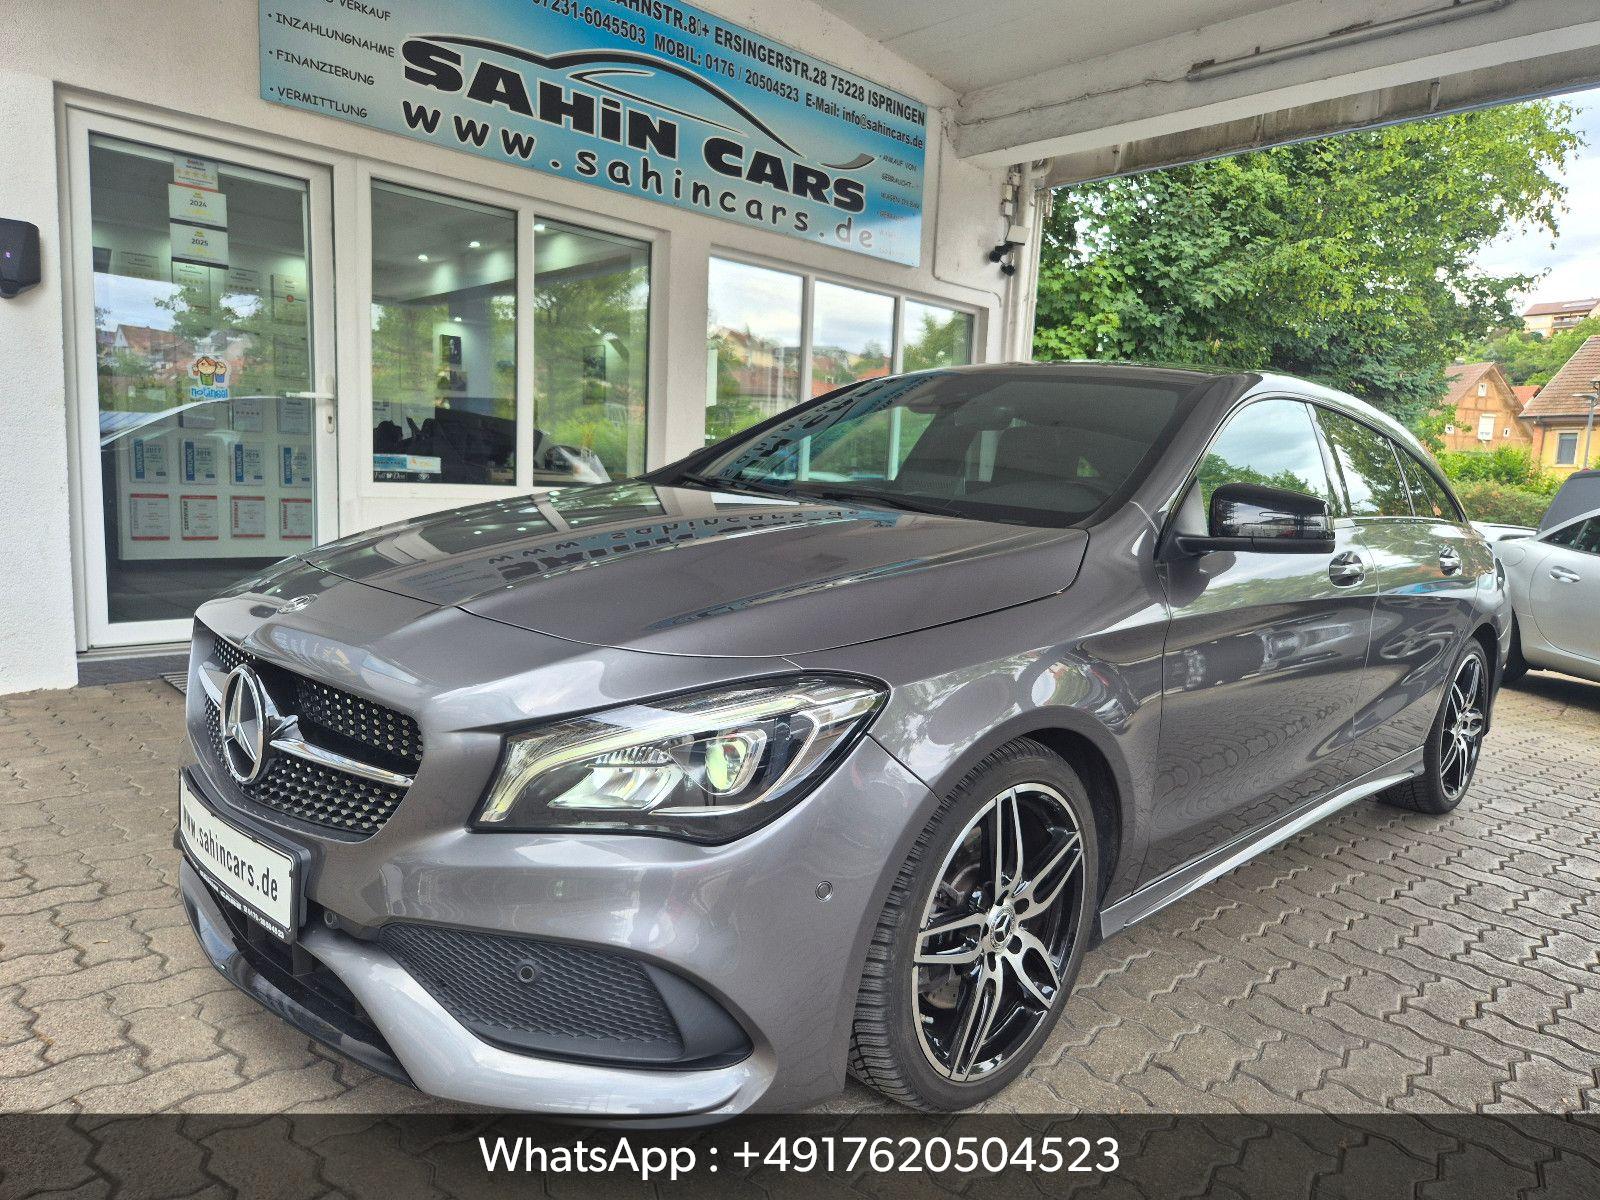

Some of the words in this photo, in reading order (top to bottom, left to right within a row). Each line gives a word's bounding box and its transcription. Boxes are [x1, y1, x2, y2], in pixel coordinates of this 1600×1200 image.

[340, 0, 391, 21] VERKAUF
[276, 12, 395, 57] INZAHLUNGNAHME
[276, 49, 375, 86] FINANZIERUNG
[532, 0, 645, 45] 231-6045503
[654, 34, 701, 65] MOBIL:
[705, 54, 734, 78] 0176
[745, 68, 799, 102] 20504523
[805, 92, 839, 118] E-Mail:
[842, 107, 923, 149] info@sahincars.de
[715, 26, 827, 87] ERSINGERSTR.28
[831, 74, 865, 102] 75228
[867, 90, 925, 126] ISPRINGEN
[277, 86, 367, 118] VERMITTLUNG
[703, 137, 865, 213] CARS
[189, 199, 208, 208] 2024
[191, 238, 209, 247] 2025
[183, 803, 278, 902] www.sahincars.de
